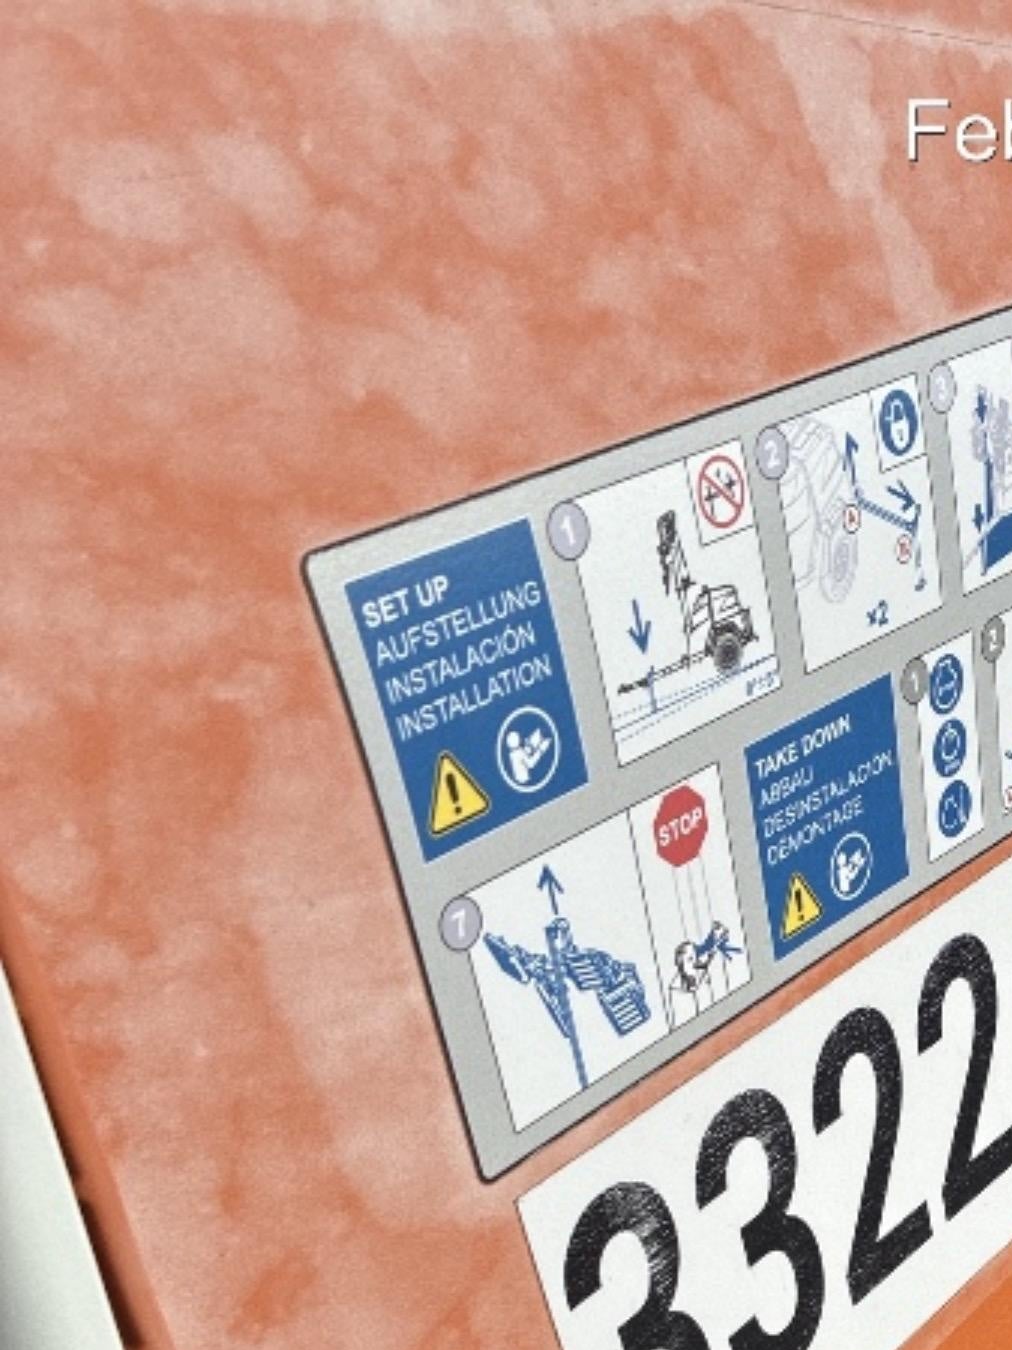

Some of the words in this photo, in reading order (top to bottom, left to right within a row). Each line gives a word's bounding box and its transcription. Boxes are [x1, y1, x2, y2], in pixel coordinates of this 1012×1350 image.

[362, 590, 412, 629] SET
[417, 574, 450, 608] UP
[375, 580, 541, 667] AUFSTELLUNG
[866, 600, 889, 626] x2
[385, 620, 536, 705] INSTALACIÓN
[397, 654, 553, 742] INSTALLATION
[754, 741, 799, 780] TAKE
[802, 714, 851, 757] DOWN
[759, 765, 814, 809] ABBAU
[658, 808, 704, 848] STOP
